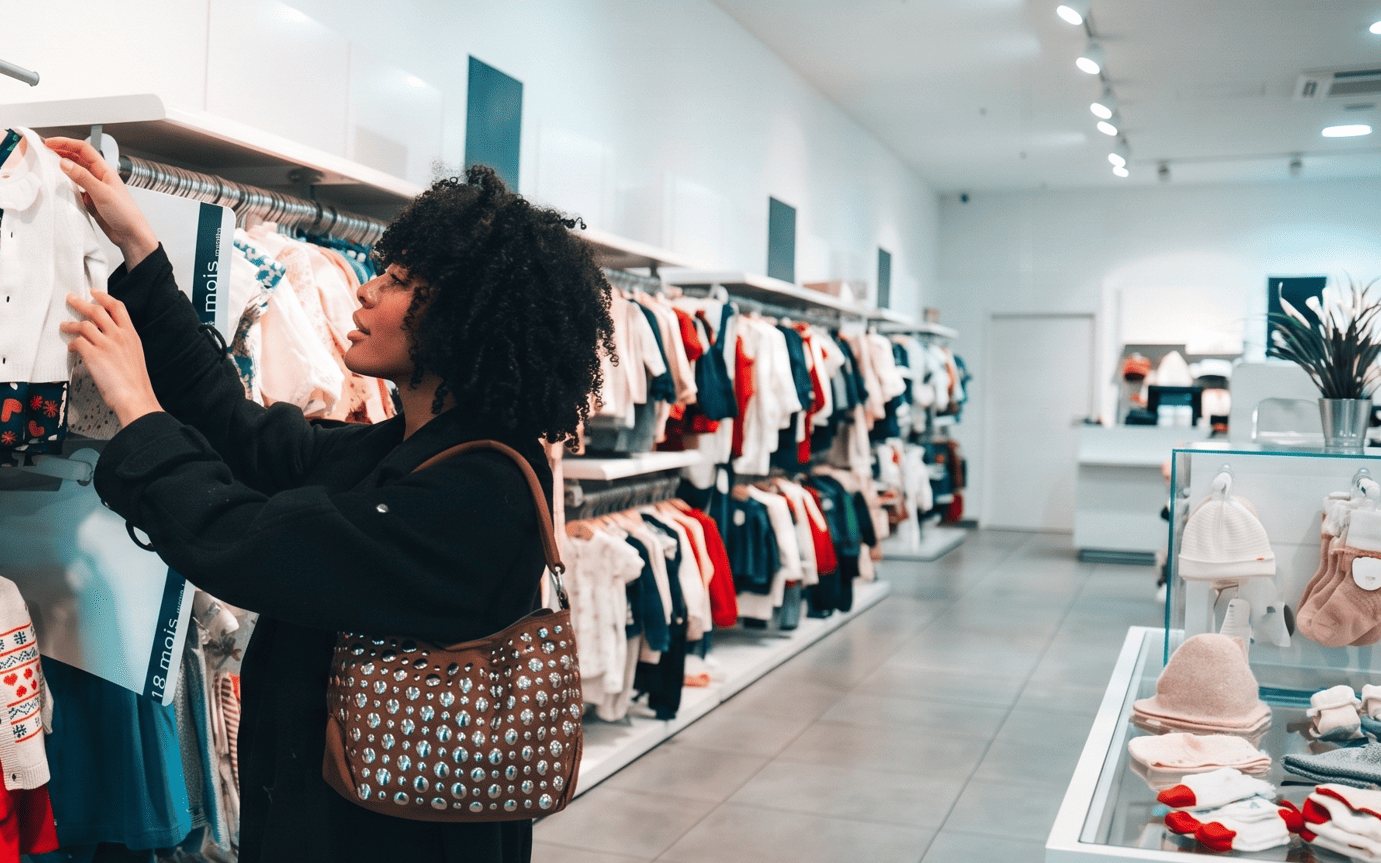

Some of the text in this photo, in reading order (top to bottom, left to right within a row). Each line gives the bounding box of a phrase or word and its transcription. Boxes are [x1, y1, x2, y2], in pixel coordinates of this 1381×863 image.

[202, 261, 218, 312] mois
[151, 618, 178, 698] 18 mois
